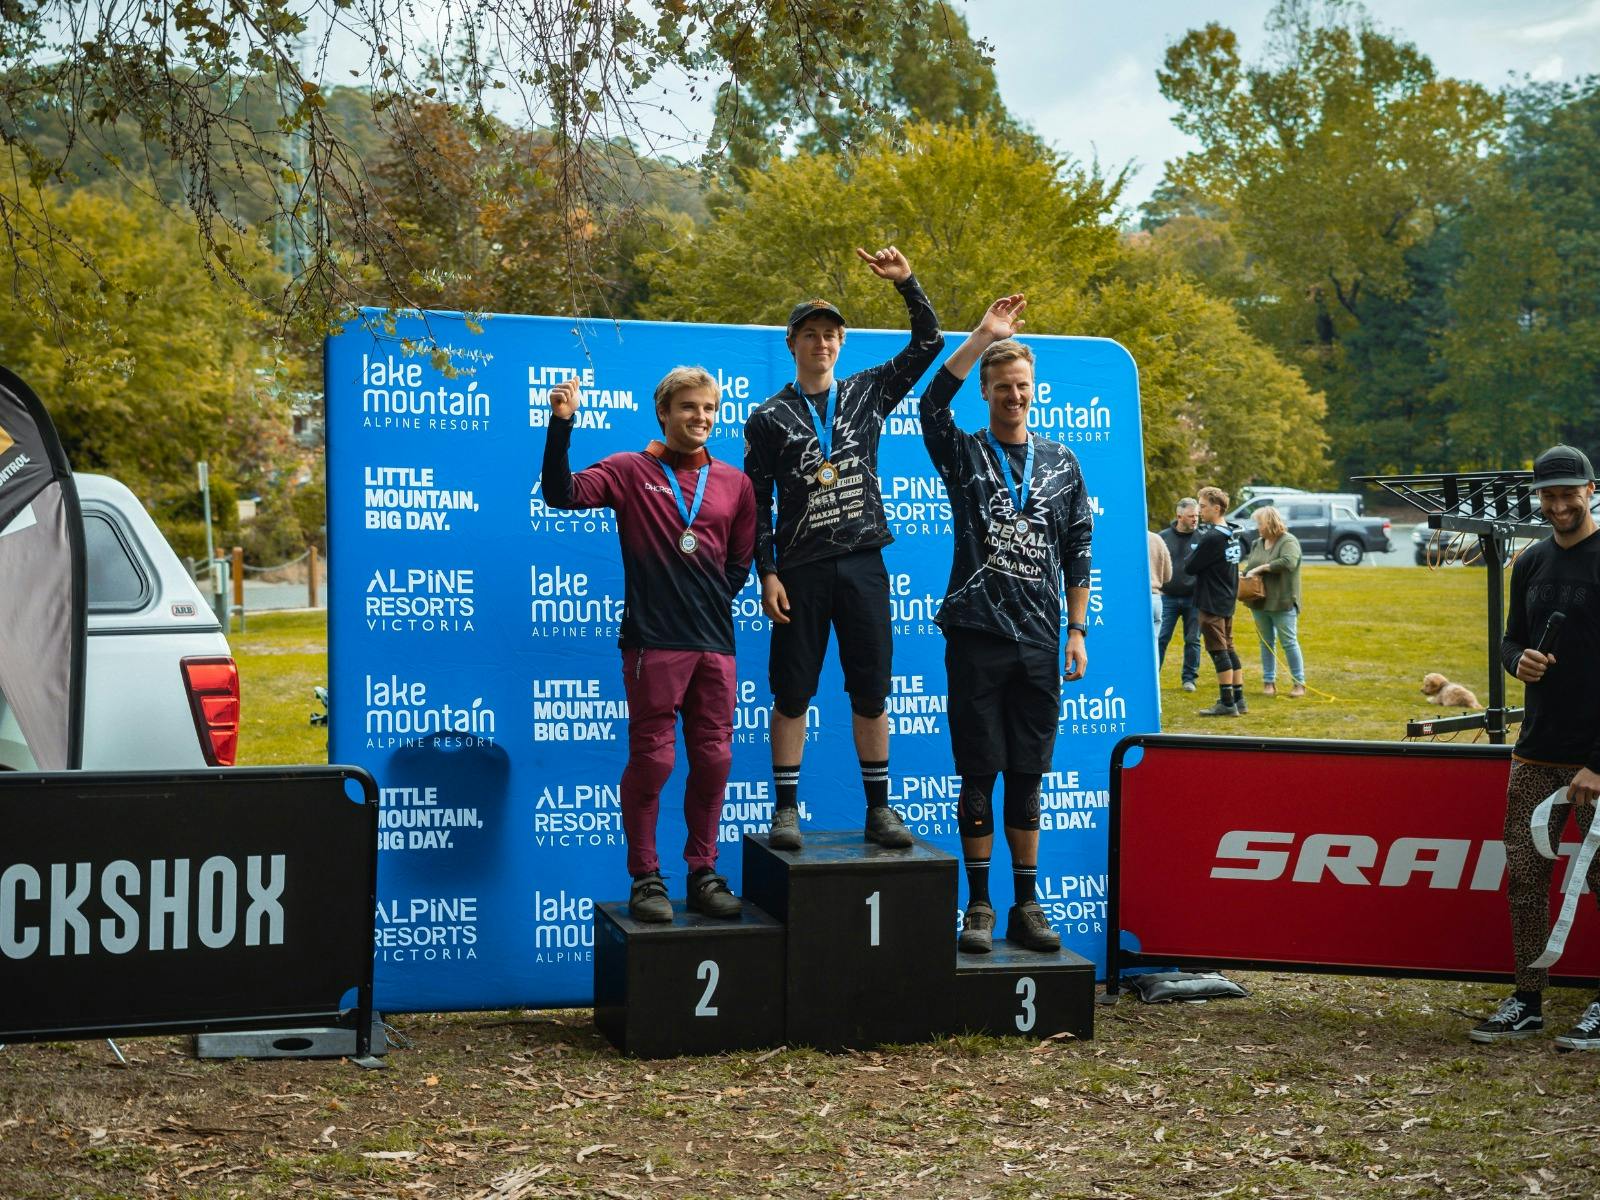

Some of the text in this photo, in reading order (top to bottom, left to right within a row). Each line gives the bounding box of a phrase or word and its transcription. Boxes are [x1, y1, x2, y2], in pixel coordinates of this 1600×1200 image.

[363, 353, 422, 388] lake
[363, 381, 490, 417] mountain
[528, 388, 638, 412] MNTAIN,
[1026, 396, 1110, 428] ountain
[363, 416, 490, 431] ALPINE RESORT
[1058, 432, 1110, 442] RESORT
[365, 466, 434, 488] LITTLE
[365, 488, 480, 513] MOUNTAIN,
[365, 510, 450, 531] BIG DAY.
[809, 508, 840, 522] MAXXIS
[883, 502, 952, 521] SORTS
[530, 520, 618, 532] VICTORI
[893, 523, 952, 535] TORIA
[984, 536, 1047, 560] ADDICTION
[988, 554, 1042, 576] MONARCH
[531, 564, 588, 596] lake
[366, 596, 474, 618] RESORTS
[532, 594, 625, 623] mounta
[366, 619, 474, 632] VICTORIA
[532, 626, 622, 638] ALPINE RES
[918, 624, 942, 635] RES
[366, 674, 426, 706] lake
[534, 680, 600, 698] LITTLE
[366, 697, 495, 734] mountain
[534, 700, 630, 720] MOUNTAI
[534, 722, 616, 742] BIG DAY.
[900, 716, 940, 734] DAY.
[1072, 722, 1126, 735] RESORT
[366, 736, 495, 748] ALPINE RESORT
[380, 787, 438, 806] ITTLE
[535, 812, 623, 832] RESORT
[1056, 811, 1096, 830] DAY.
[409, 830, 454, 850] DAY.
[536, 834, 624, 848] VICTORI
[0, 854, 286, 960] CKSHOX
[536, 890, 593, 922] lake
[1040, 901, 1108, 921] ESORT
[866, 891, 880, 946] 1
[536, 952, 592, 963] ALPINE
[695, 960, 720, 1016] 2
[1015, 976, 1036, 1032] 3
